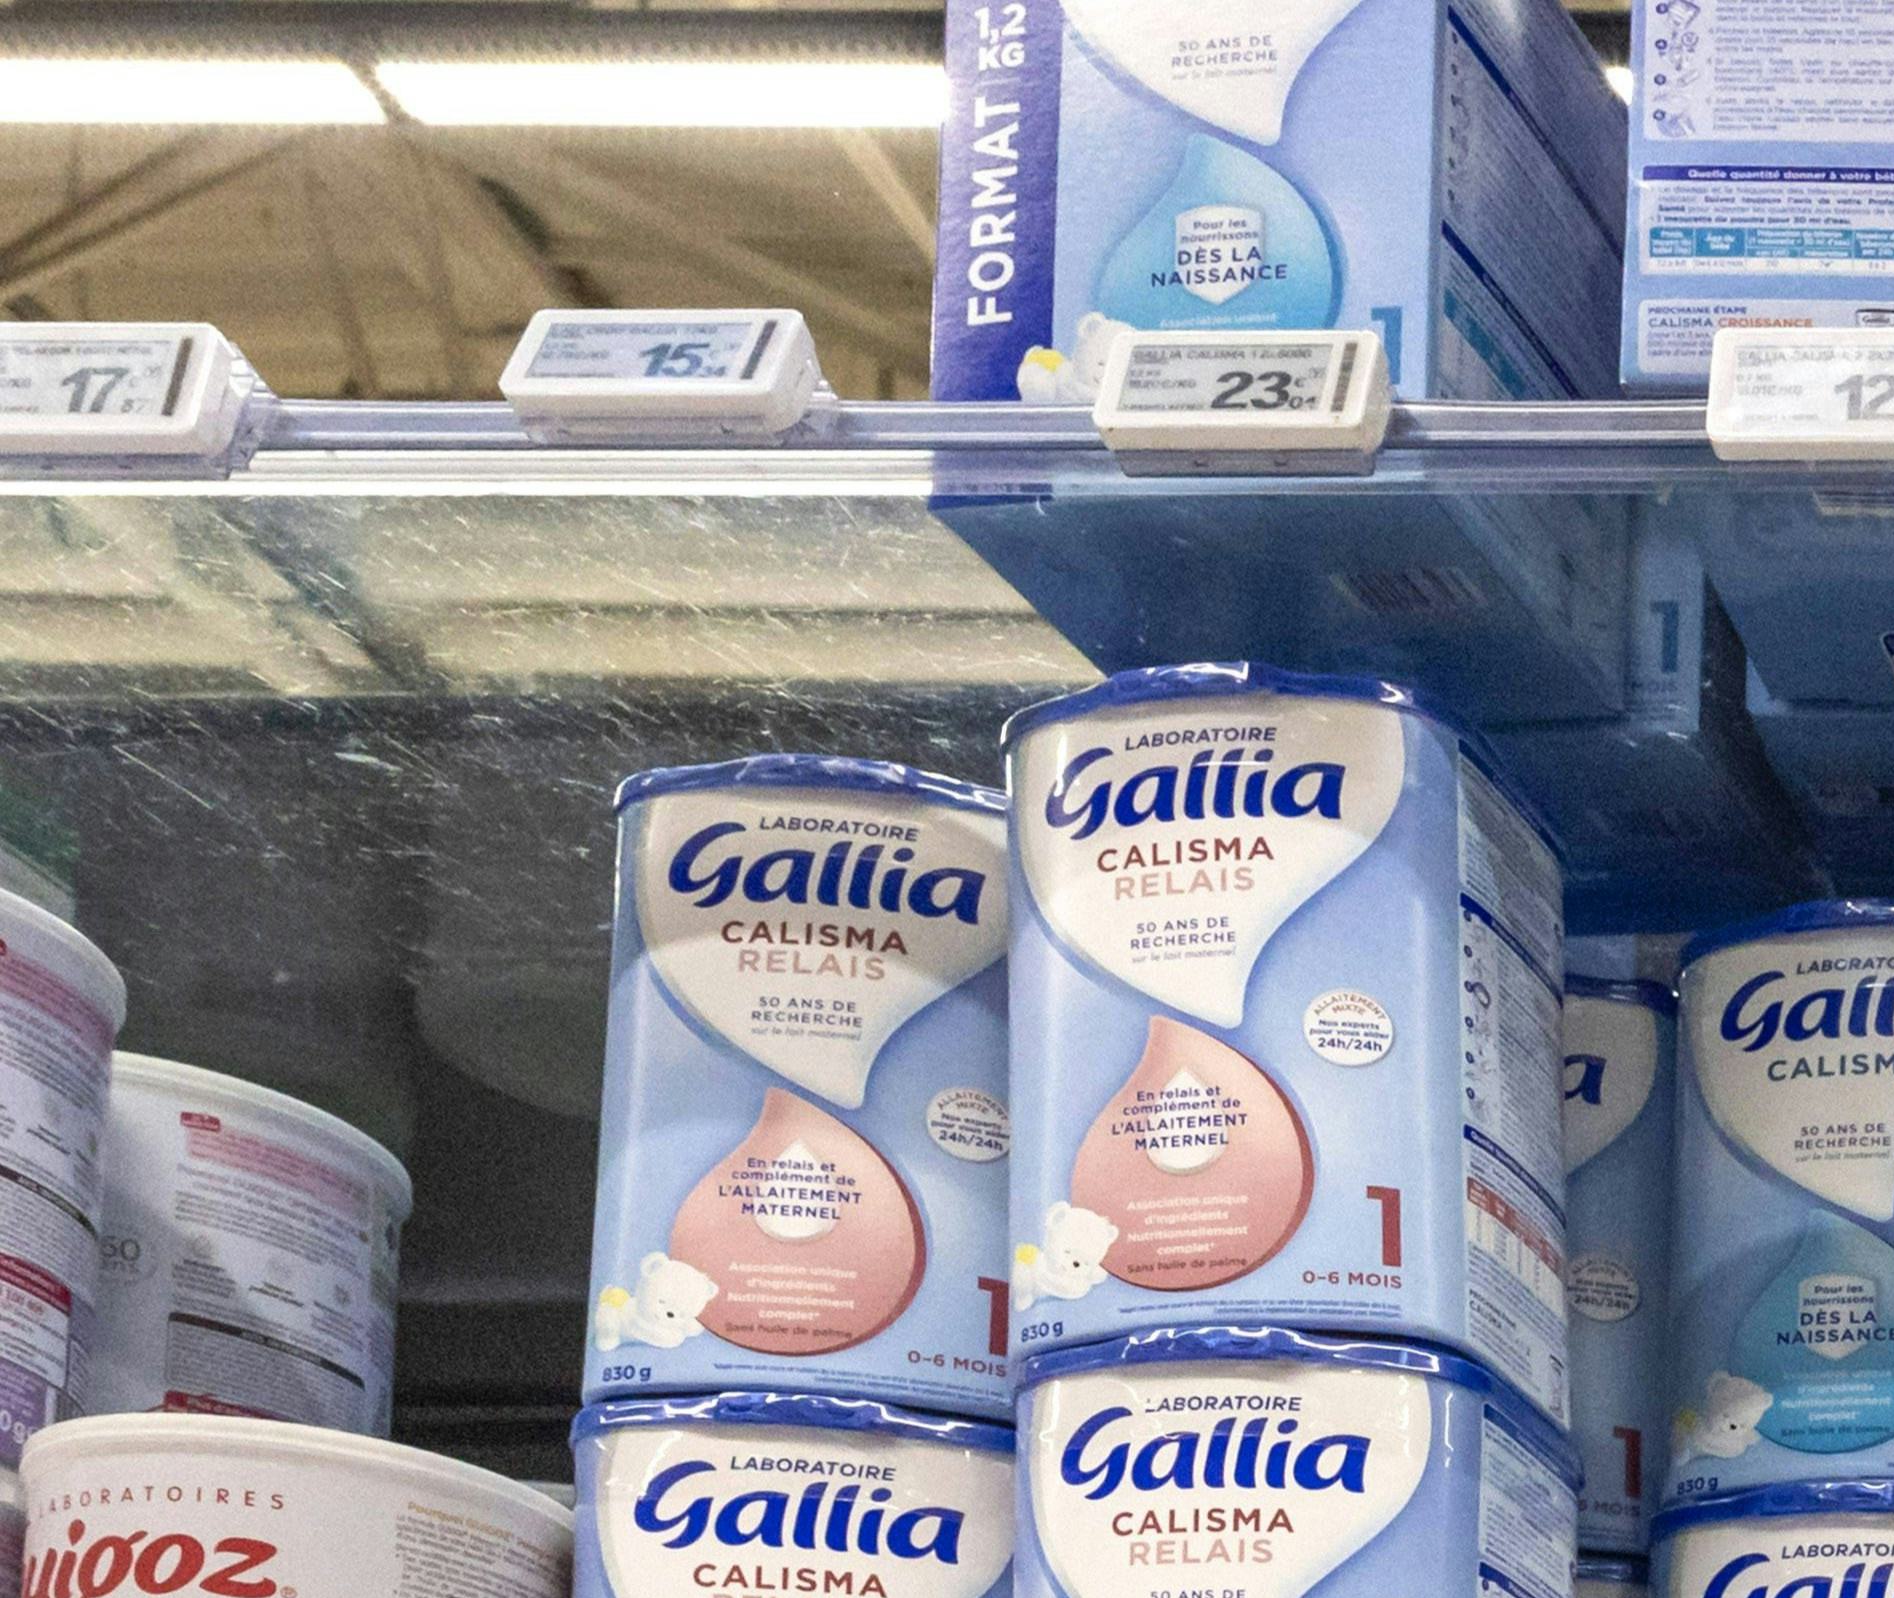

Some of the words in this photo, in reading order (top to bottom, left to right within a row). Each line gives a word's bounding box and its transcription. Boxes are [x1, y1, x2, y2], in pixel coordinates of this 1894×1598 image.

[967, 98, 1022, 326] FORMAT
[1211, 371, 1292, 411] 23
[1124, 727, 1278, 751] LABORATOIRE
[1045, 747, 1346, 841] Gallia
[1096, 836, 1274, 872] CALISMA
[668, 821, 987, 926] Gallia
[1114, 867, 1256, 901] RELAIS
[721, 920, 908, 956] CALISMA
[1111, 1112, 1248, 1136] L'ALLAITEMENT
[1134, 1131, 1230, 1152] MATERNEL
[1366, 1184, 1402, 1267] 1
[1302, 1270, 1340, 1288] 0-6
[1347, 1271, 1403, 1289] MOIS
[1060, 1406, 1372, 1500] Gallia
[1112, 1508, 1295, 1537] CALISMA
